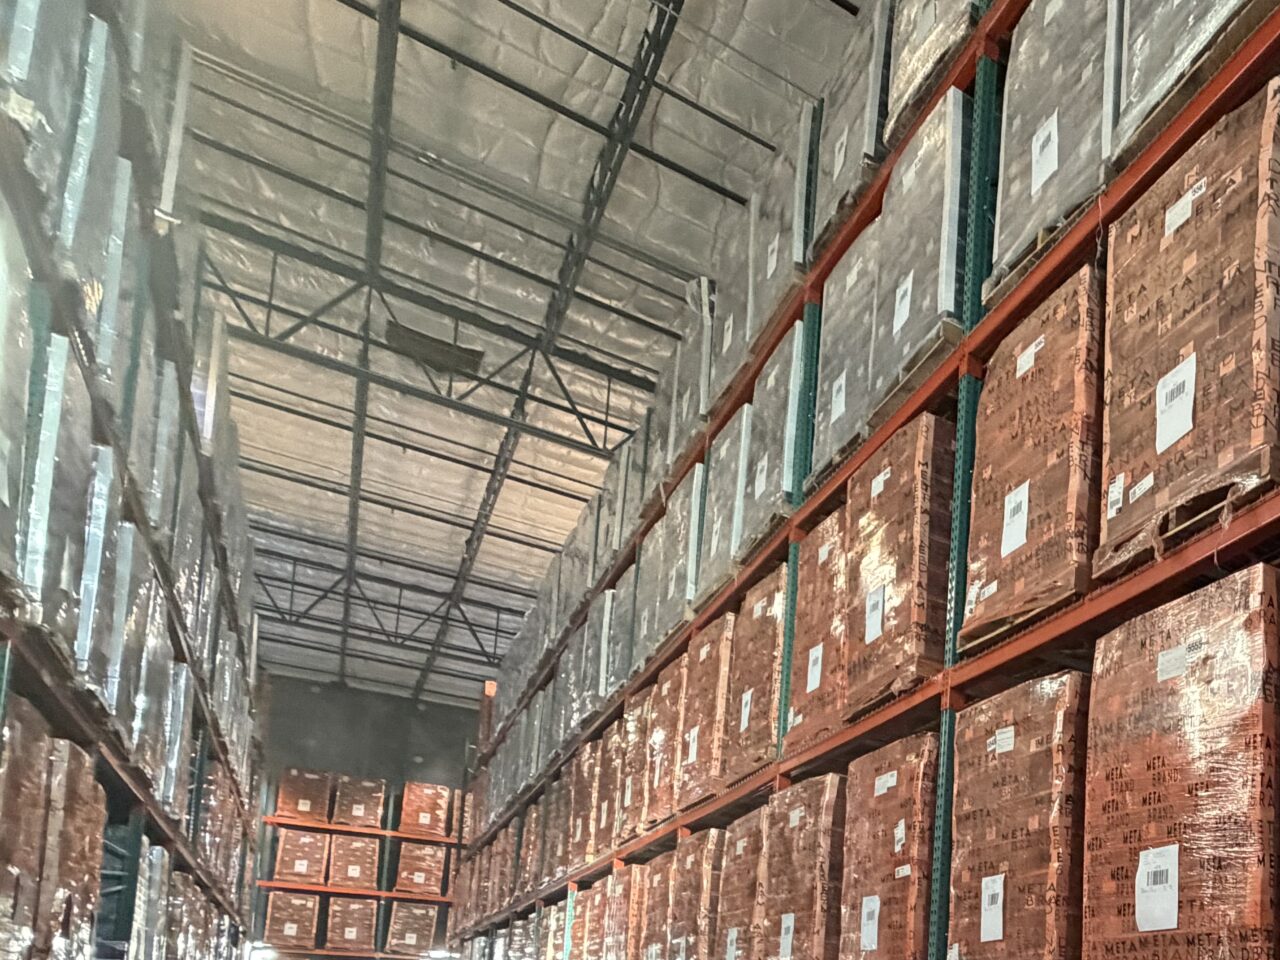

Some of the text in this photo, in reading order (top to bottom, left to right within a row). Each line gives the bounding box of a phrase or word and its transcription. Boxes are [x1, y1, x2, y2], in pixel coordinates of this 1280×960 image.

[1146, 755, 1167, 772] META
[1105, 766, 1124, 781] META
[1102, 799, 1120, 814] META
[1142, 791, 1163, 807] META
[1001, 828, 1032, 841] META
[1123, 829, 1142, 845] META
[968, 861, 996, 873] META
[1111, 866, 1130, 881] META
[1018, 882, 1056, 895] META
[1104, 940, 1138, 955] META
[1138, 935, 1180, 949] META
[1186, 932, 1224, 948] META
